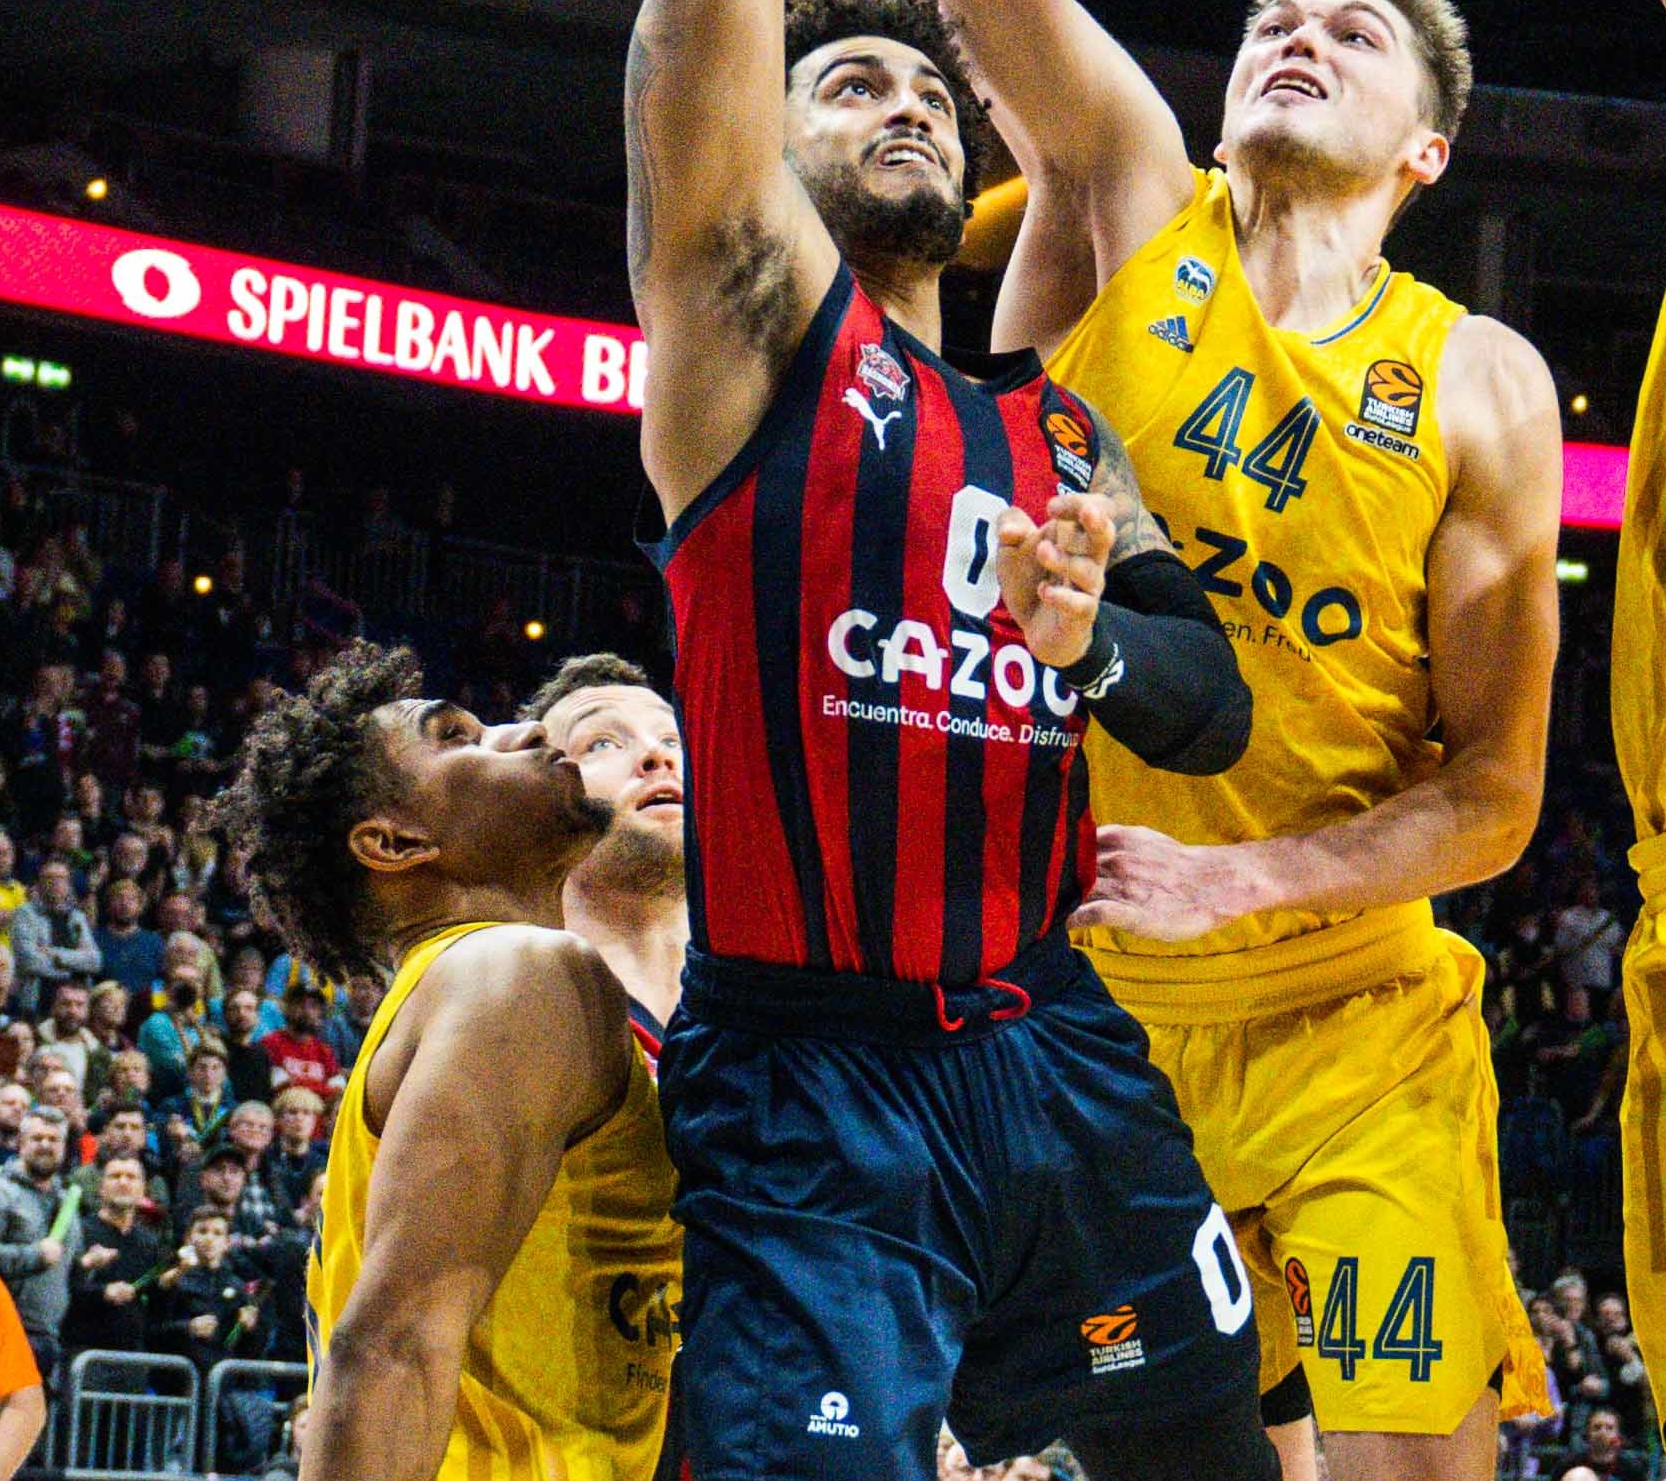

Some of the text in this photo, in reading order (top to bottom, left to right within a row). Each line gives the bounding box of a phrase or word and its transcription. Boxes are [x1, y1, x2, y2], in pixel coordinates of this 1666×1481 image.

[227, 267, 555, 396] SPIELBANK
[1172, 366, 1321, 515] 44
[942, 485, 1010, 619] 0
[822, 694, 933, 731] Encuentra.
[936, 709, 1014, 742] Conduce.
[1191, 1202, 1253, 1336] 0
[1318, 1256, 1443, 1383] 44
[808, 1420, 860, 1438] AMUTIO
